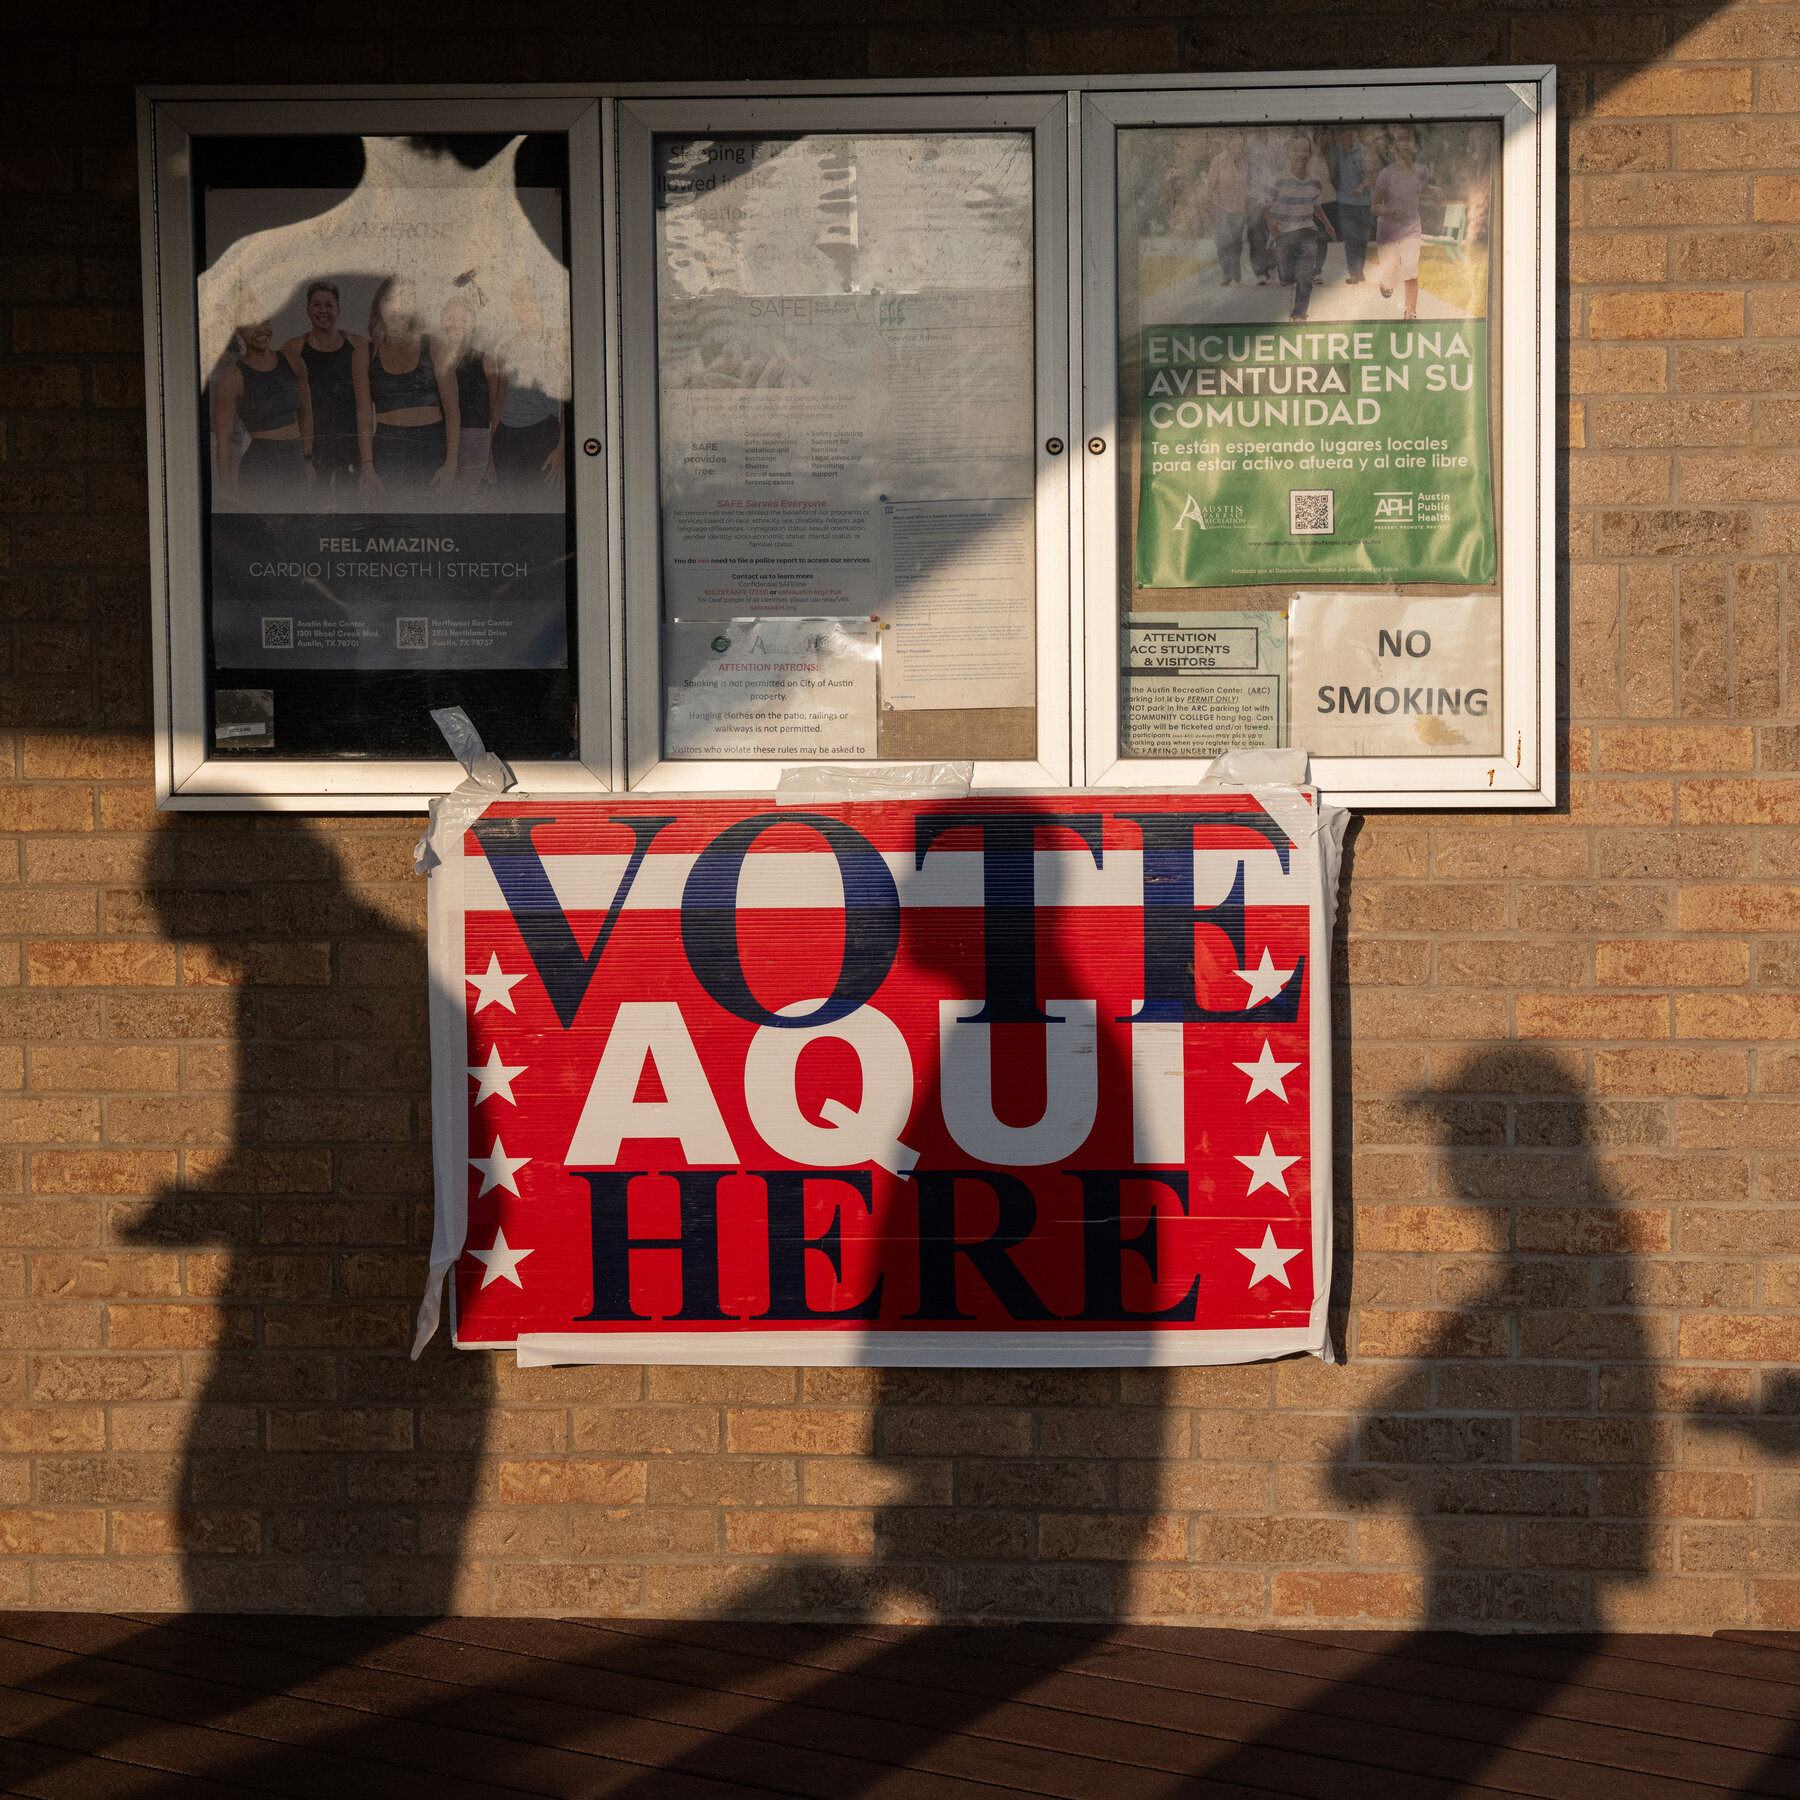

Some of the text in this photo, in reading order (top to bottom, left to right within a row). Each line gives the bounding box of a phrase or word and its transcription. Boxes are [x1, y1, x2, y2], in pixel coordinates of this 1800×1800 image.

[671, 145, 745, 164] Sleping
[749, 300, 807, 317] SAFE
[1149, 332, 1470, 363] ENCUENTRE UNA
[1148, 364, 1473, 396] AVENTURA EN SU
[1150, 398, 1381, 429] COMUNIDAD
[692, 443, 718, 451] SAFE
[1152, 437, 1448, 456] Te están esperando lugares locales
[684, 455, 726, 464] provides
[1153, 454, 1468, 475] para estar activo afuera y al aire libre
[695, 467, 716, 476] free:
[1418, 492, 1450, 500] Austin
[717, 500, 827, 508] SAFE Serves Everyone
[1375, 499, 1413, 516] APH
[1418, 503, 1450, 511] Public
[1418, 513, 1450, 521] Health
[319, 538, 460, 553] FEEL AMAZING.
[249, 562, 527, 577] CARDIO STRENGTH STRETCH
[1143, 633, 1216, 642] ATTENTION
[297, 640, 323, 648] Austin,
[432, 639, 457, 647] Austin,
[1378, 630, 1431, 657] NO
[1130, 646, 1230, 654] ACC STUDENTS
[1144, 658, 1216, 666] & VISITORS
[719, 663, 819, 672] ATTENTION PATRONS:
[684, 680, 718, 689] Smoking
[744, 680, 785, 689] permitted
[800, 680, 815, 689] City
[1248, 687, 1270, 695] (ARC)
[750, 694, 788, 702] property.
[1318, 686, 1487, 716] SMOKING
[1210, 705, 1239, 713] parking
[689, 712, 722, 721] Hanging
[724, 712, 753, 720] clothes
[768, 712, 782, 720] the
[784, 712, 807, 721] patio,
[809, 712, 838, 721] railings
[1217, 714, 1236, 722] hang
[715, 725, 822, 734] walkways is not permitted.
[672, 745, 865, 756] Visitors who violate these rules may be asked to
[464, 812, 1306, 1028] VOTE
[564, 998, 1184, 1180] AQUI
[570, 1169, 1200, 1322] HERE
